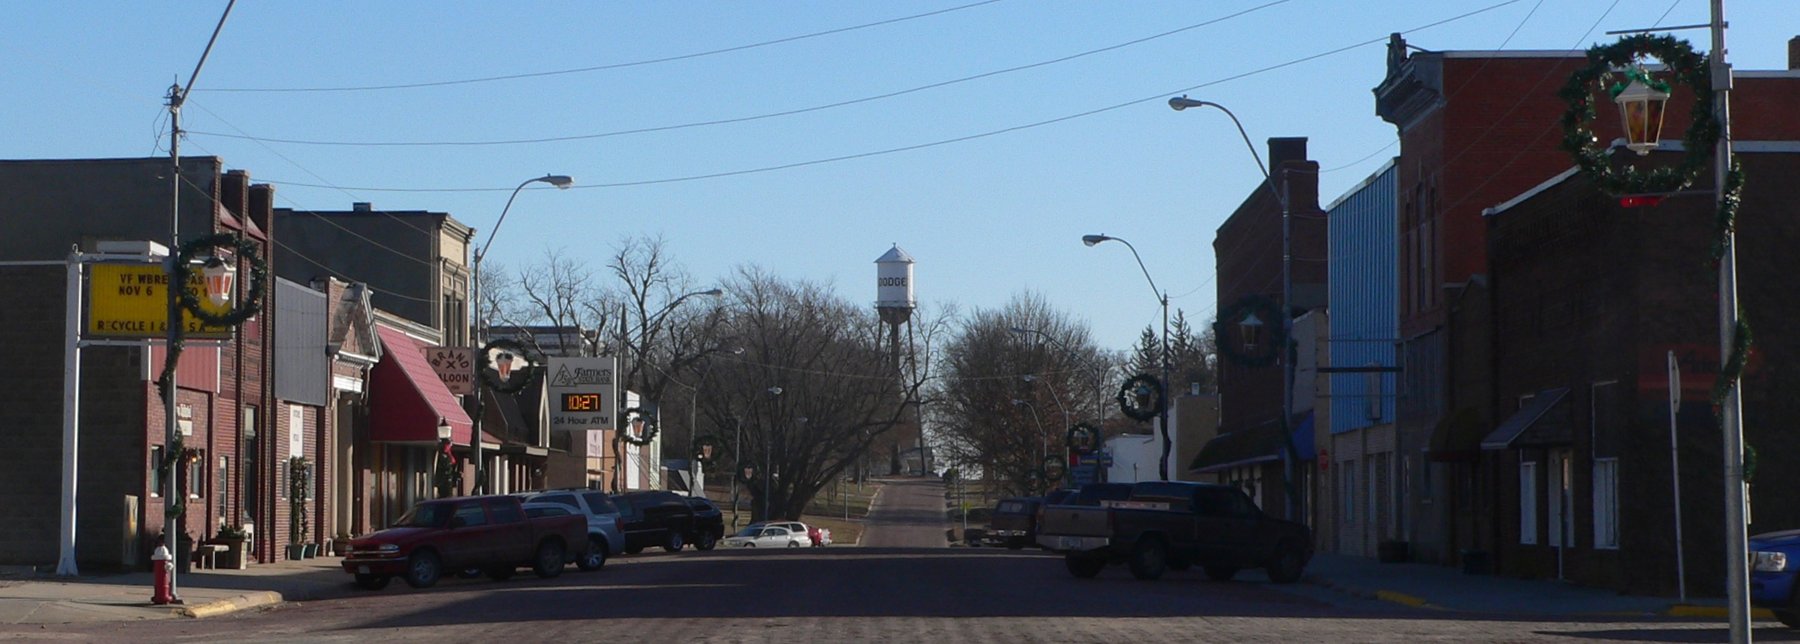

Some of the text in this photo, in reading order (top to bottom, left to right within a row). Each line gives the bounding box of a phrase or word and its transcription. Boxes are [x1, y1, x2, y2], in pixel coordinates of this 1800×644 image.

[878, 277, 907, 287] DODGE
[119, 285, 141, 296] NOV
[146, 286, 153, 296] 6
[431, 350, 470, 368] BRAND
[446, 360, 457, 370] X
[574, 367, 612, 379] Farmers
[568, 395, 599, 410] 10:27
[553, 416, 609, 425] 24 Hour ATM
